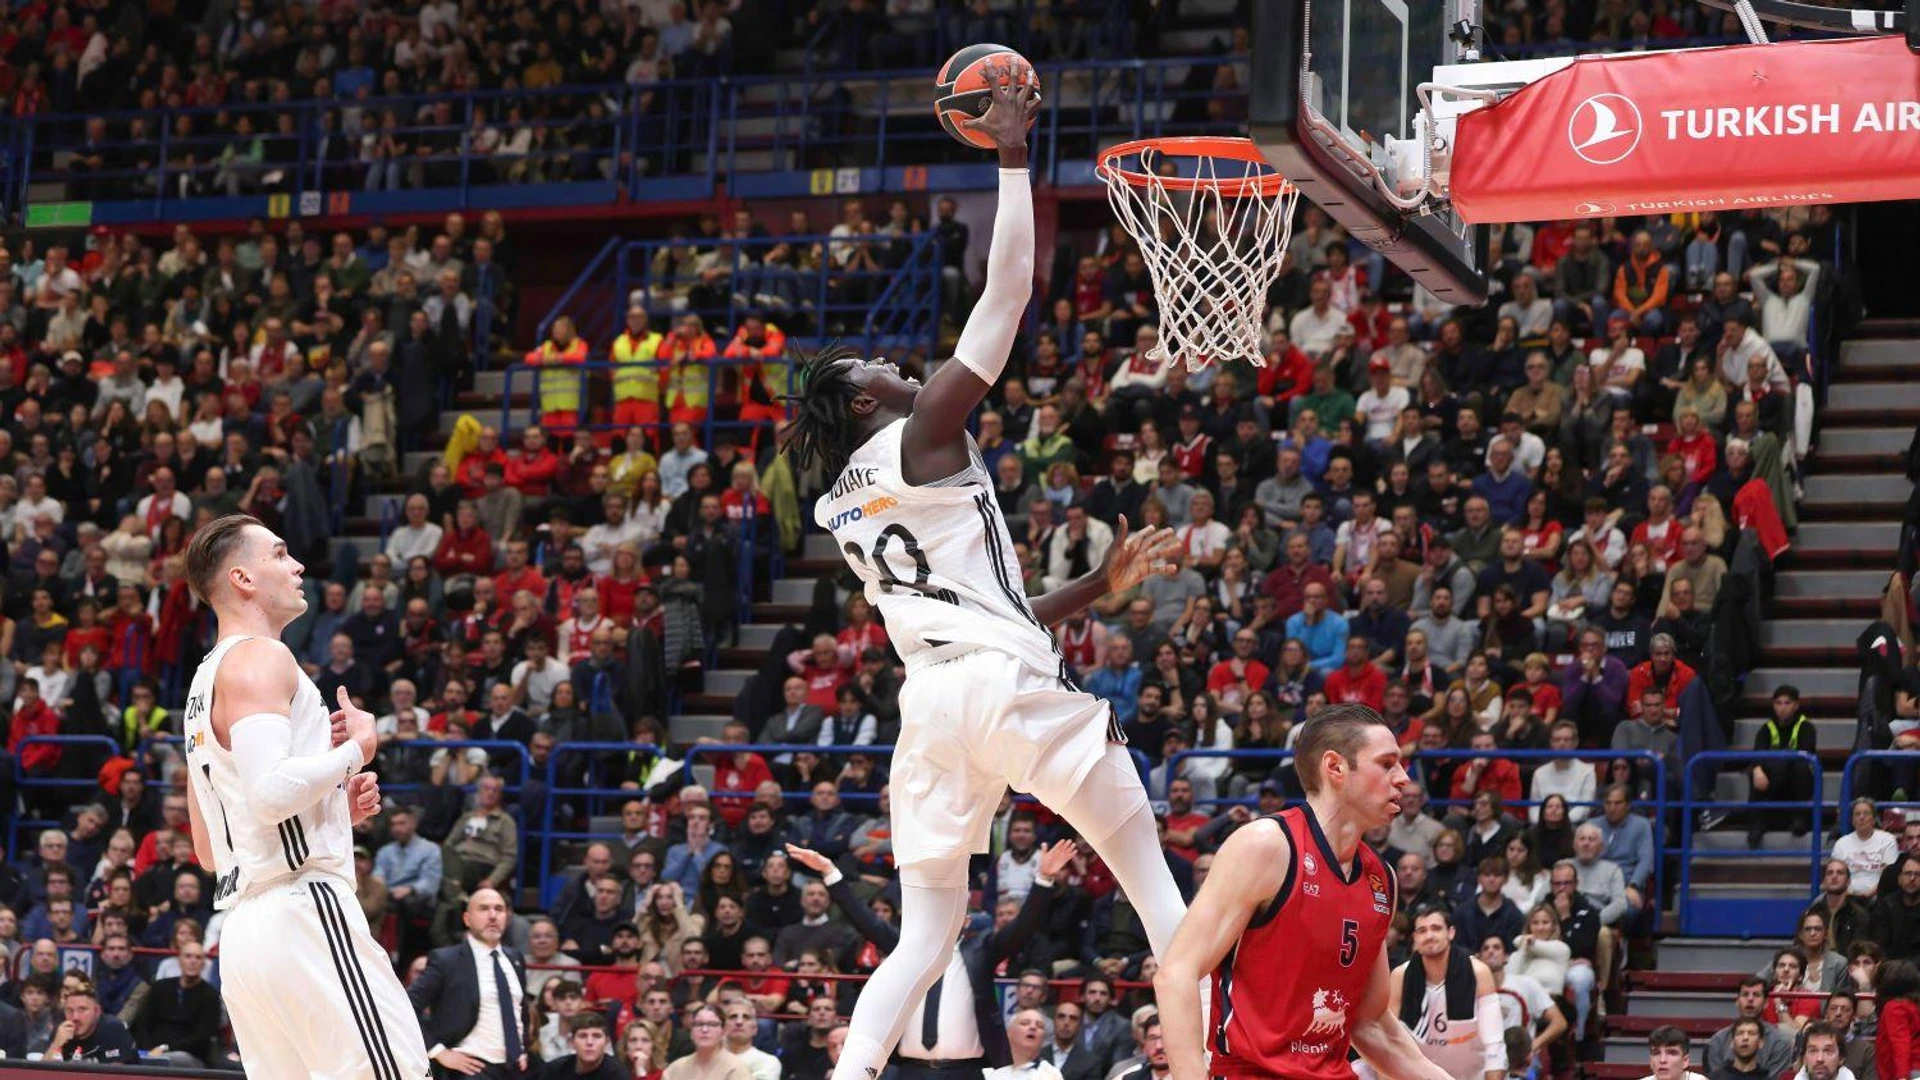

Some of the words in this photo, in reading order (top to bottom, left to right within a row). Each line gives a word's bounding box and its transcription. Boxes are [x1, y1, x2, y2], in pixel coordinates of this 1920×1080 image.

[1661, 103, 1840, 140] TURKISH
[1852, 101, 1920, 133] AIR
[1626, 198, 1724, 211] TURKISH
[1733, 192, 1833, 205] AIRLINES
[1303, 882, 1320, 896] EA7
[1338, 917, 1360, 968] 5
